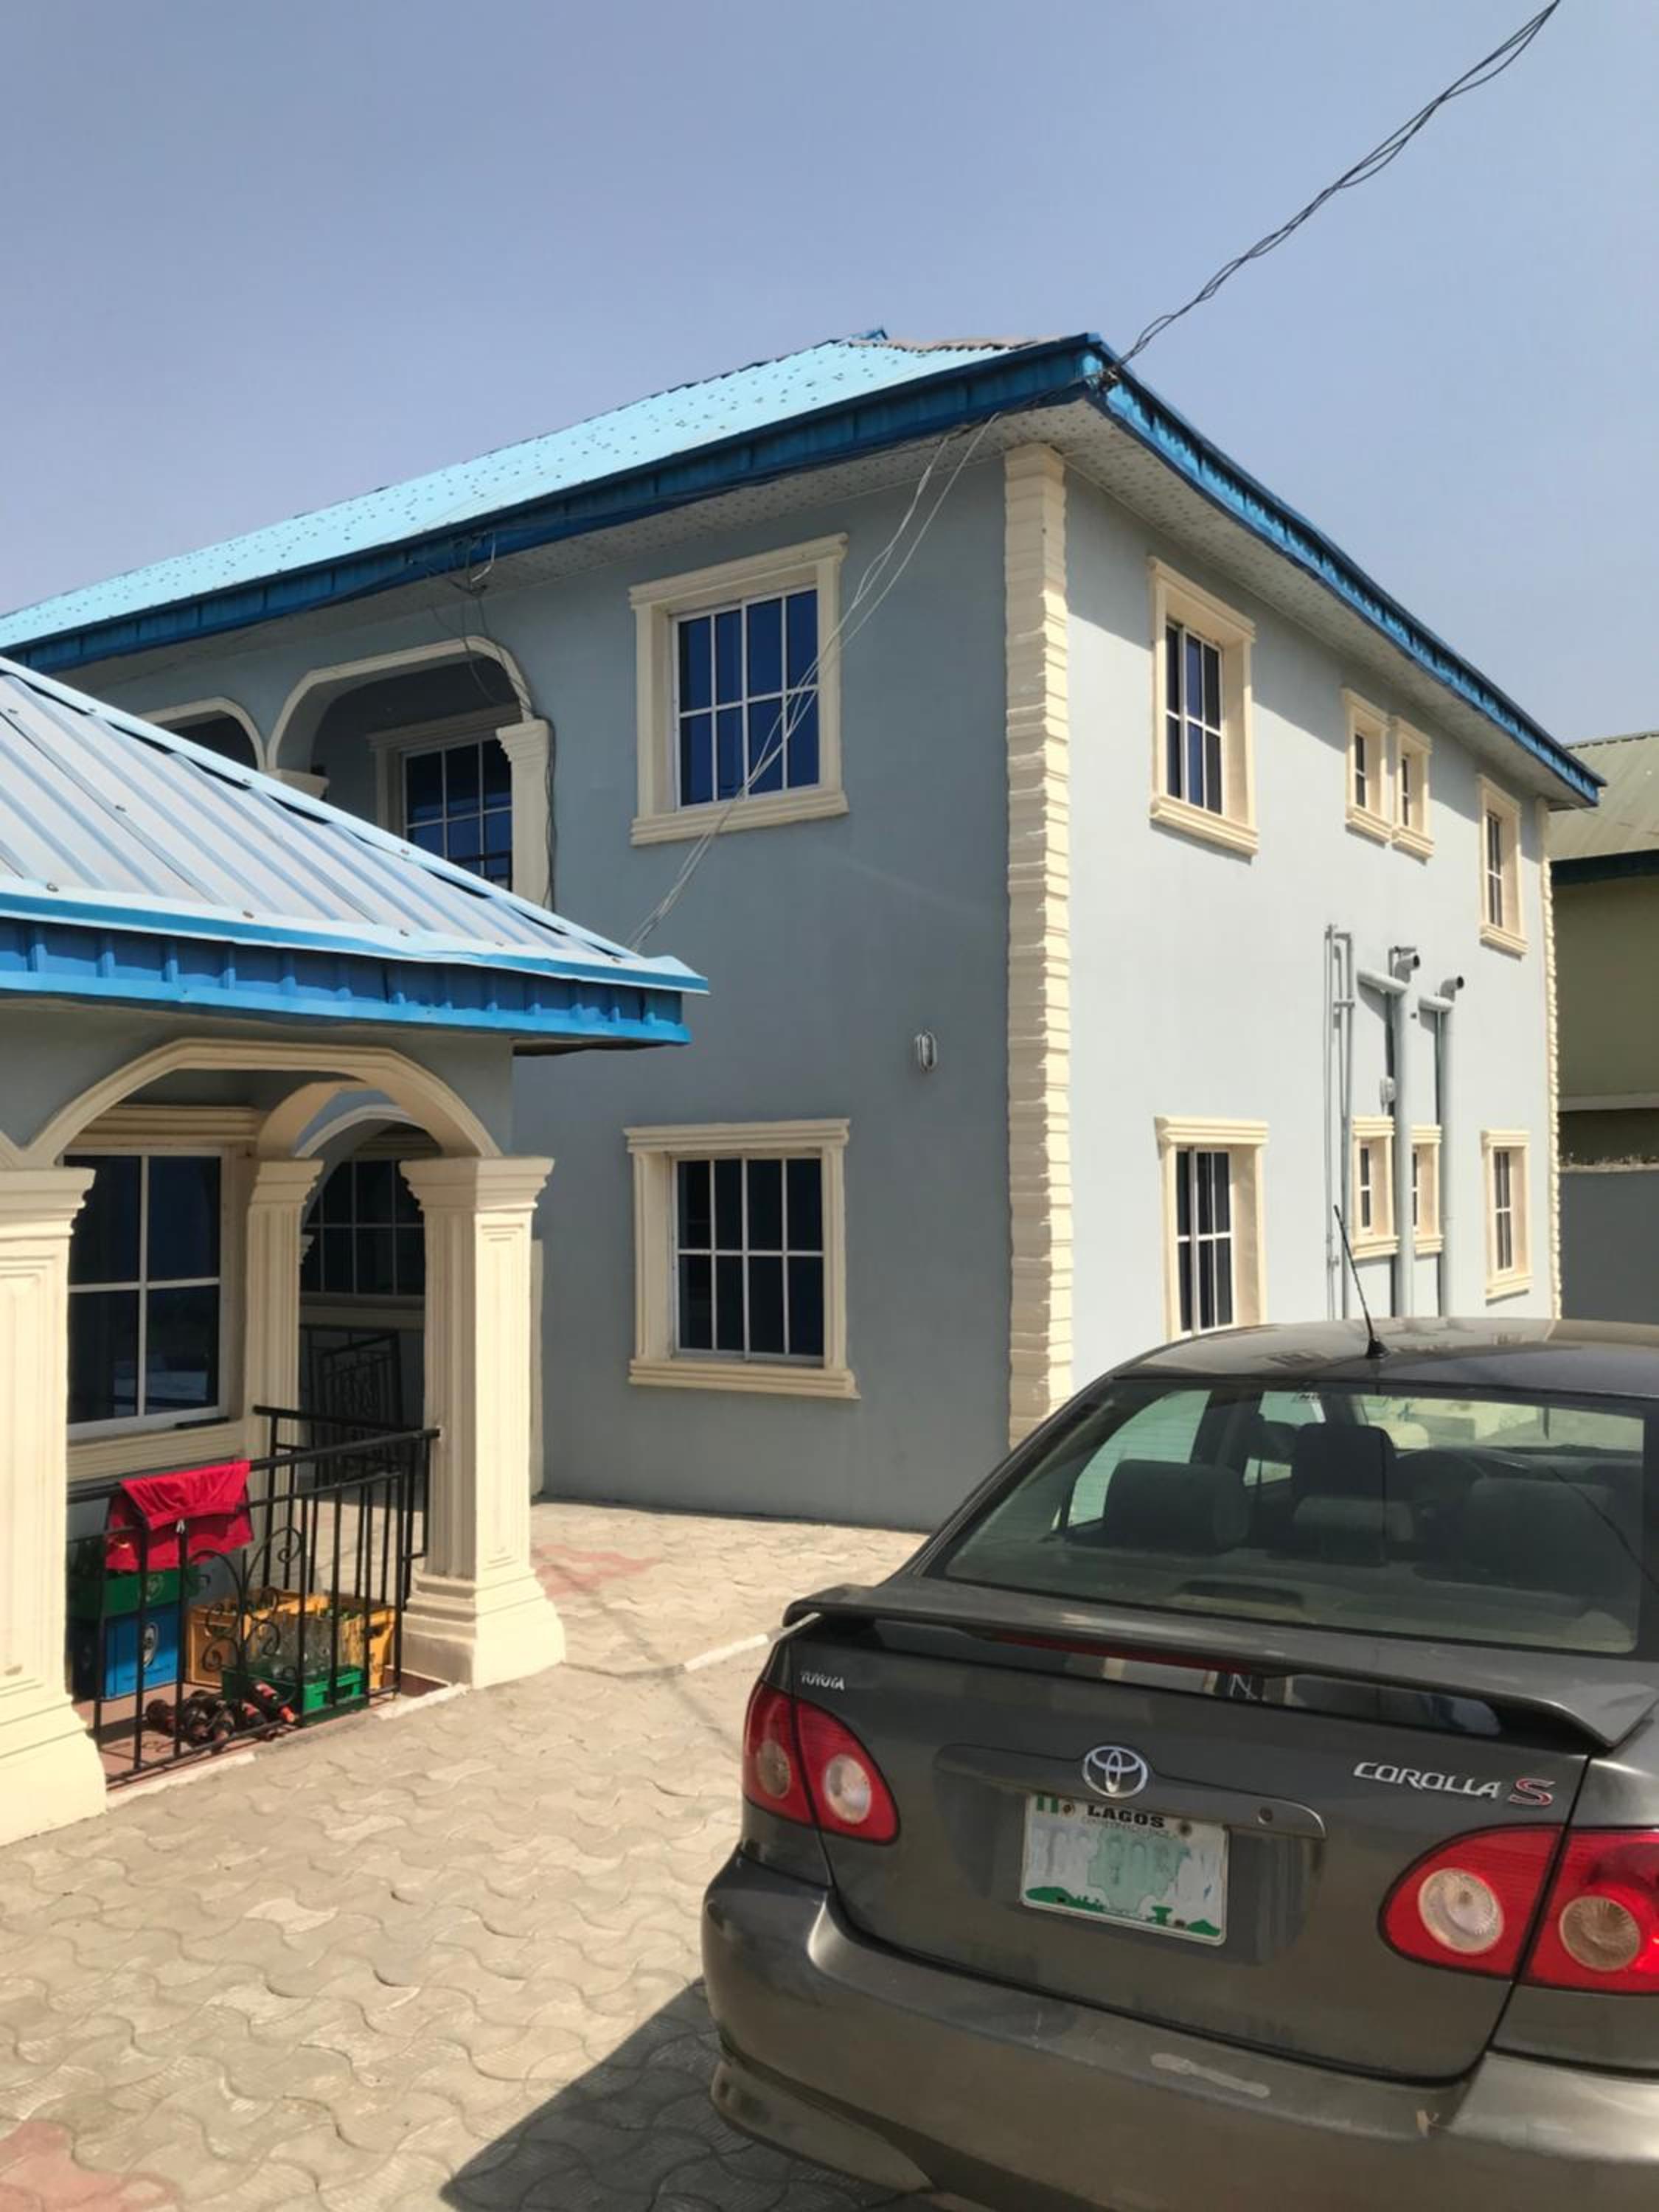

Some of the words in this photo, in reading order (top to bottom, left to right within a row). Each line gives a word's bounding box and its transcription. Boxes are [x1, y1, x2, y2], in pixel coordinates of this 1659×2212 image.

[1354, 1762, 1501, 1798] COROLLA
[1508, 1778, 1555, 1806] S
[1087, 1805, 1165, 1828] LAGOS
